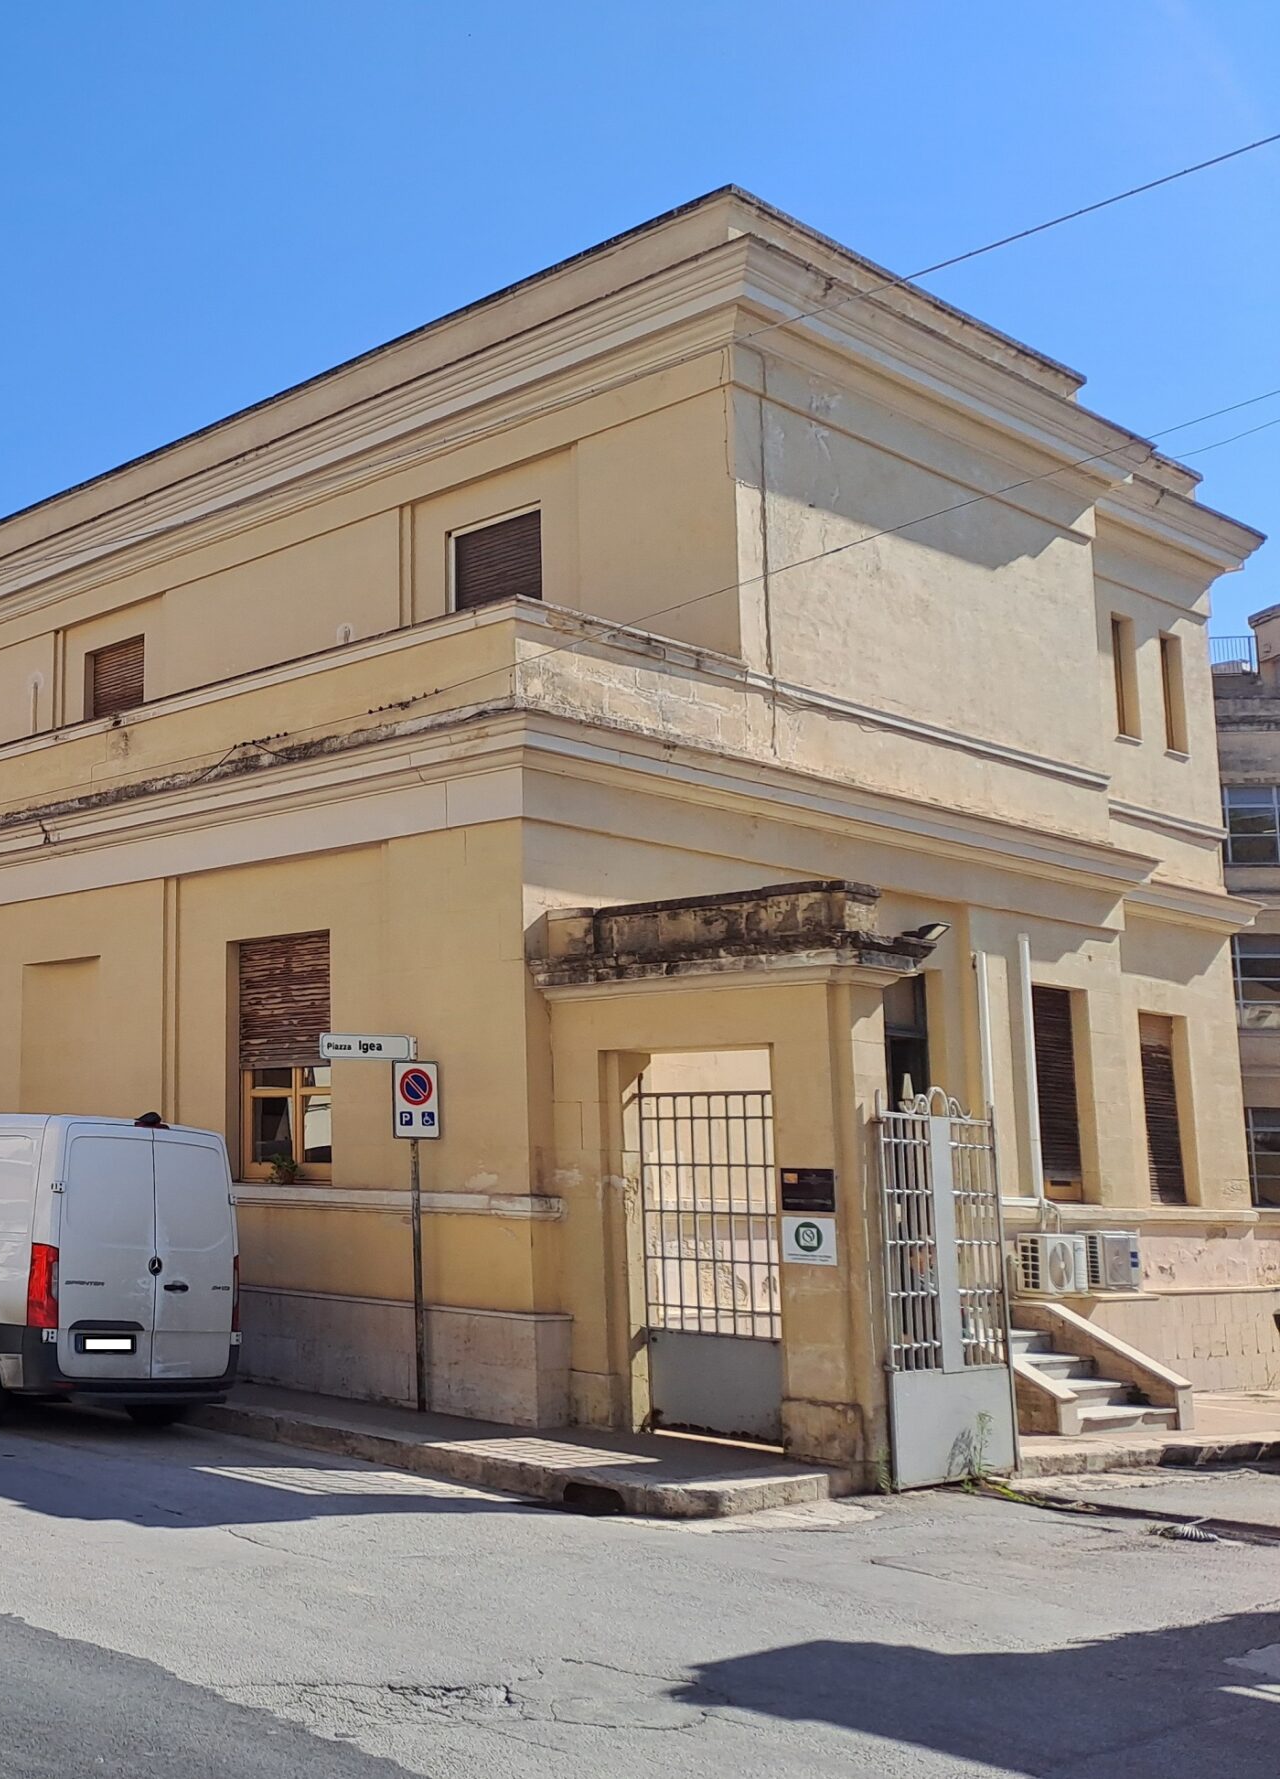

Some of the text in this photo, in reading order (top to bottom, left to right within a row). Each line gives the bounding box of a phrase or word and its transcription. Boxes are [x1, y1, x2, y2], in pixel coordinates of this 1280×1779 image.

[327, 1040, 382, 1053] Piazza Igea
[402, 1114, 410, 1124] P
